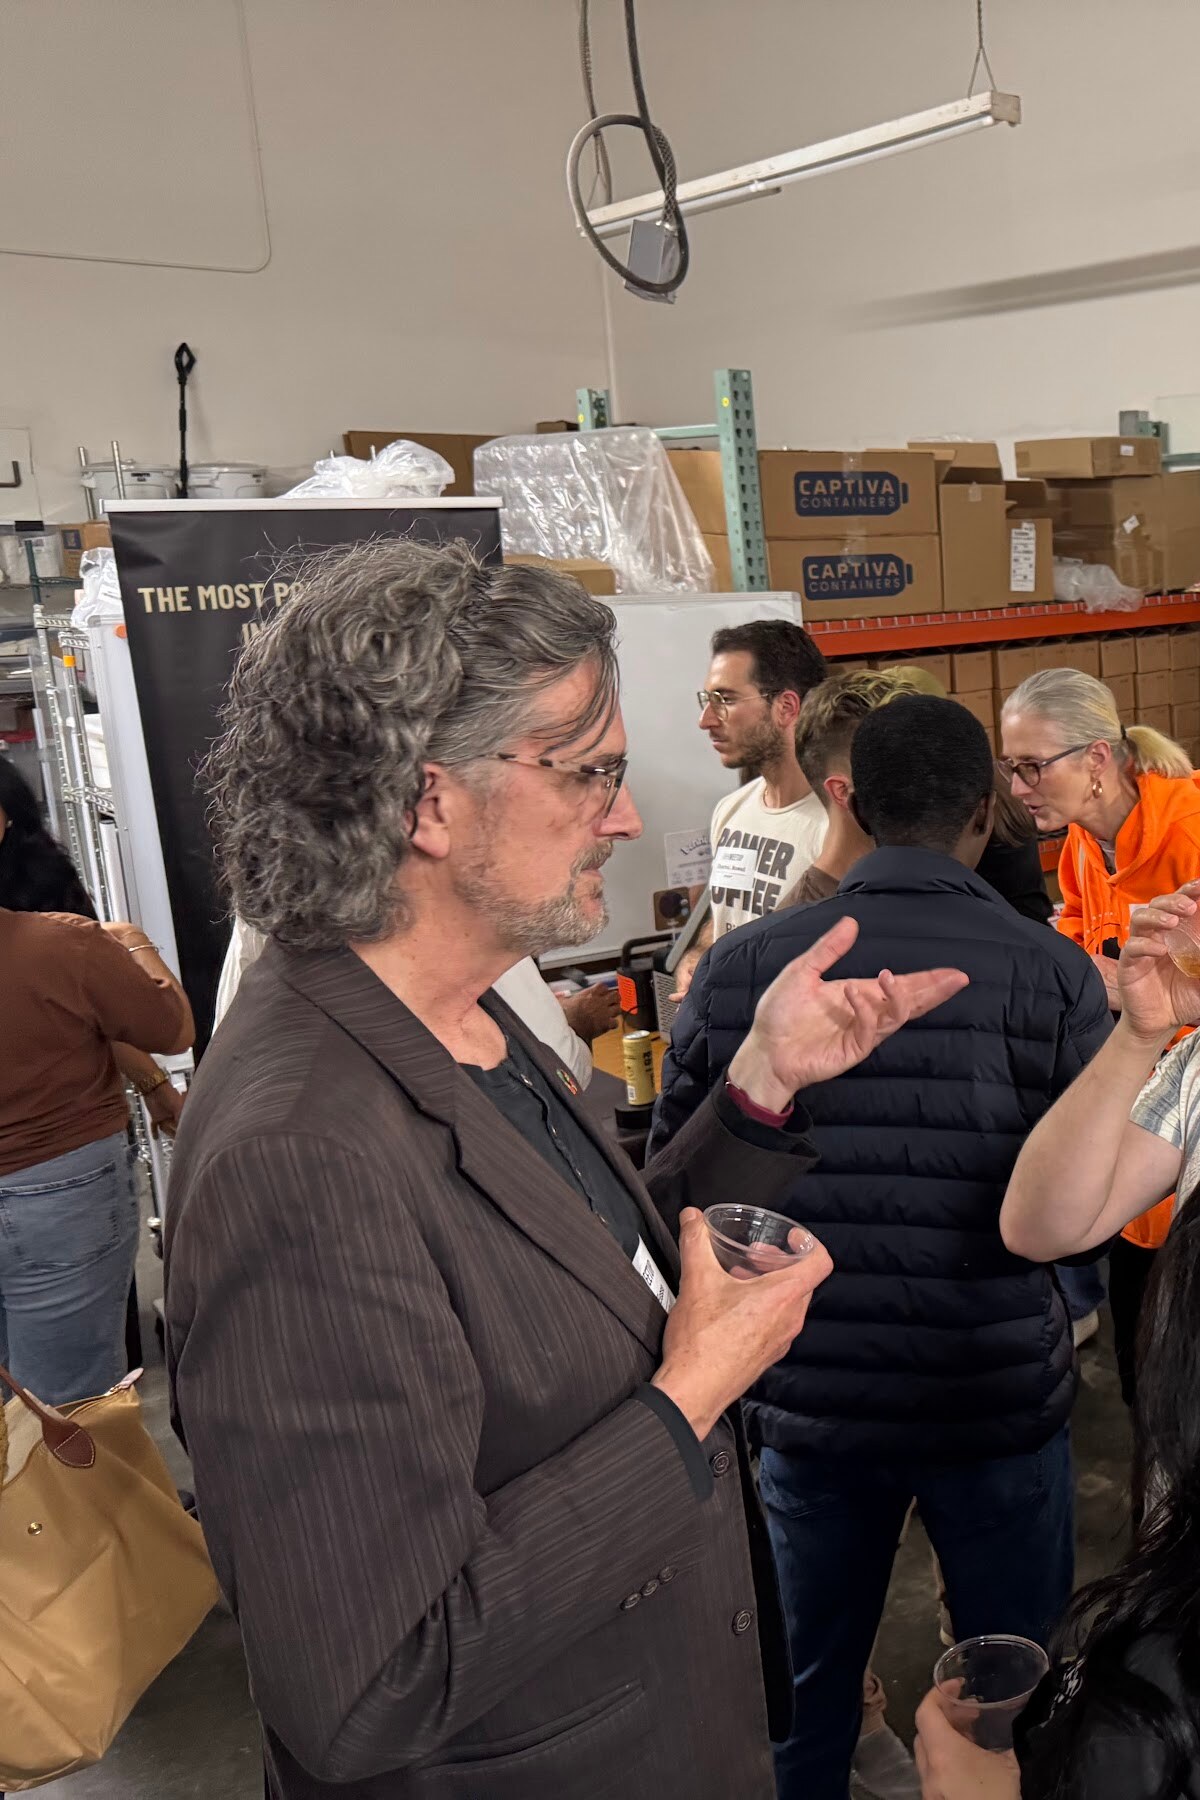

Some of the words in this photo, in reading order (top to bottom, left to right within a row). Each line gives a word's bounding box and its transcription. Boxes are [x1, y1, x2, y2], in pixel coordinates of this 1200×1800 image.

[799, 479, 895, 496] CAPTIVA
[800, 497, 896, 509] CONTAINERS
[808, 561, 900, 580] CAPTIVA
[809, 577, 901, 593] CONTAINERS
[137, 585, 192, 614] THE
[197, 582, 265, 611] MOST
